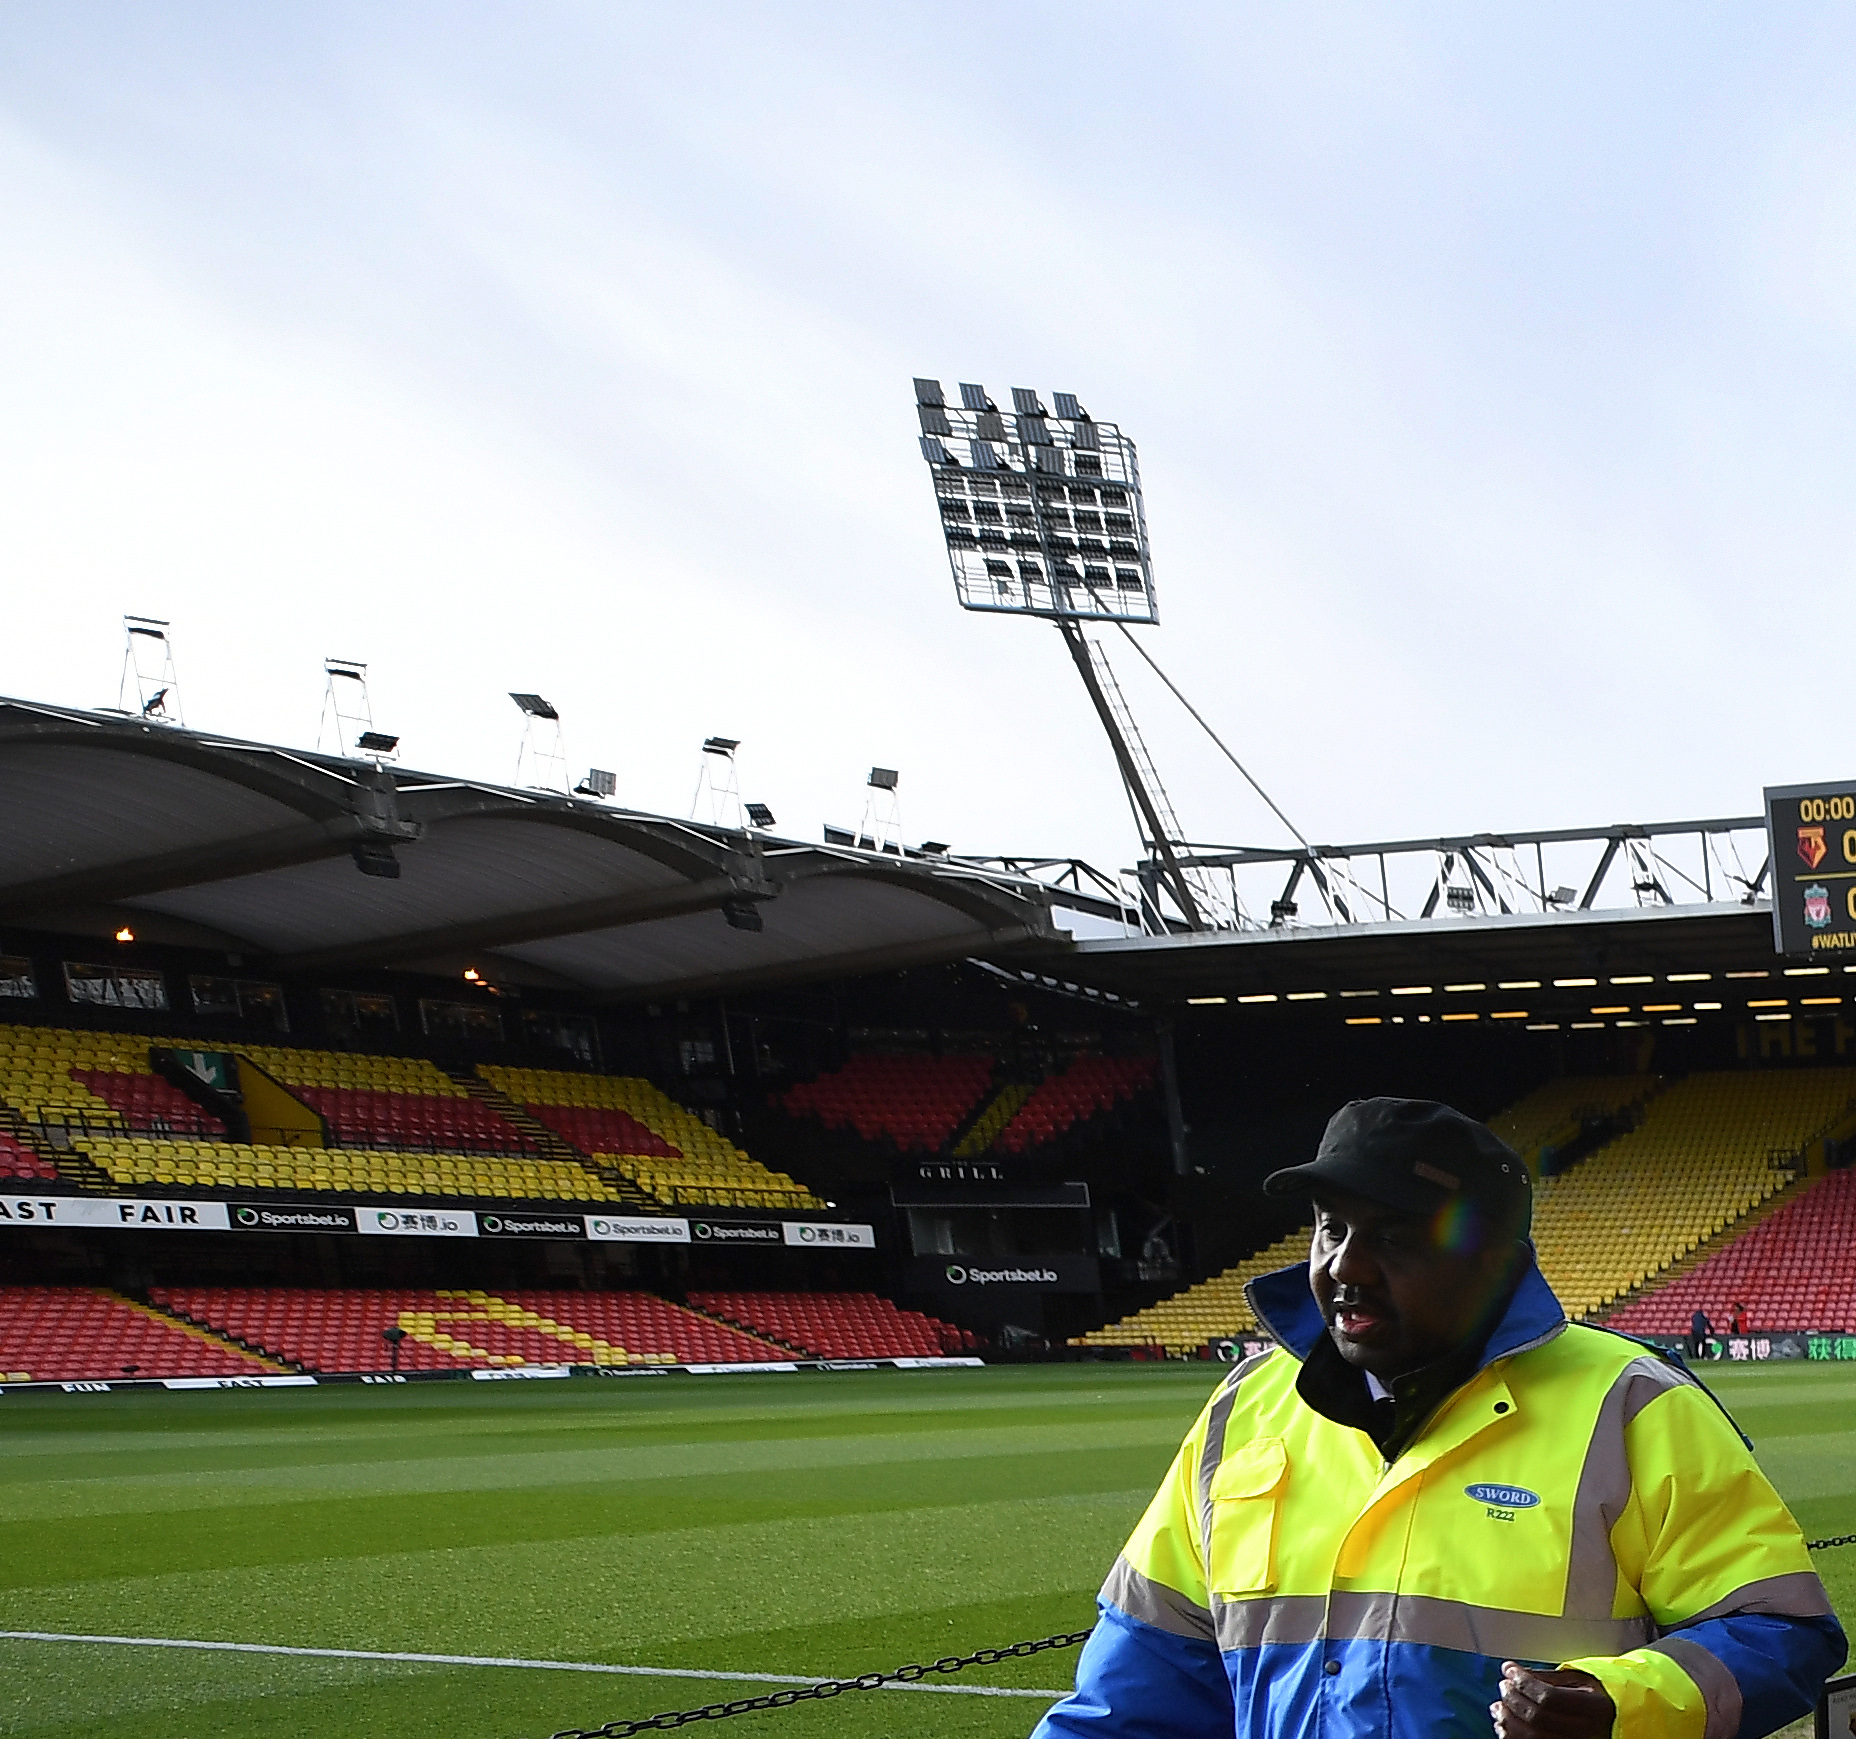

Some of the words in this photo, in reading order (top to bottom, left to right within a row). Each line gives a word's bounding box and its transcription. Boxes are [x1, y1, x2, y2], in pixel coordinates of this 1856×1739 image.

[1801, 796, 1855, 822] 00:00
[119, 1203, 200, 1225] FAIR
[261, 1211, 350, 1227] Sportsbet.io
[504, 1219, 580, 1234] Sportsbet.io
[612, 1223, 684, 1237] Sportsbet.io
[713, 1226, 780, 1240] Sportsbet.io
[969, 1267, 1058, 1284] Sportsbet.io
[1475, 1487, 1531, 1505] SWORD
[1486, 1507, 1515, 1522] R222
